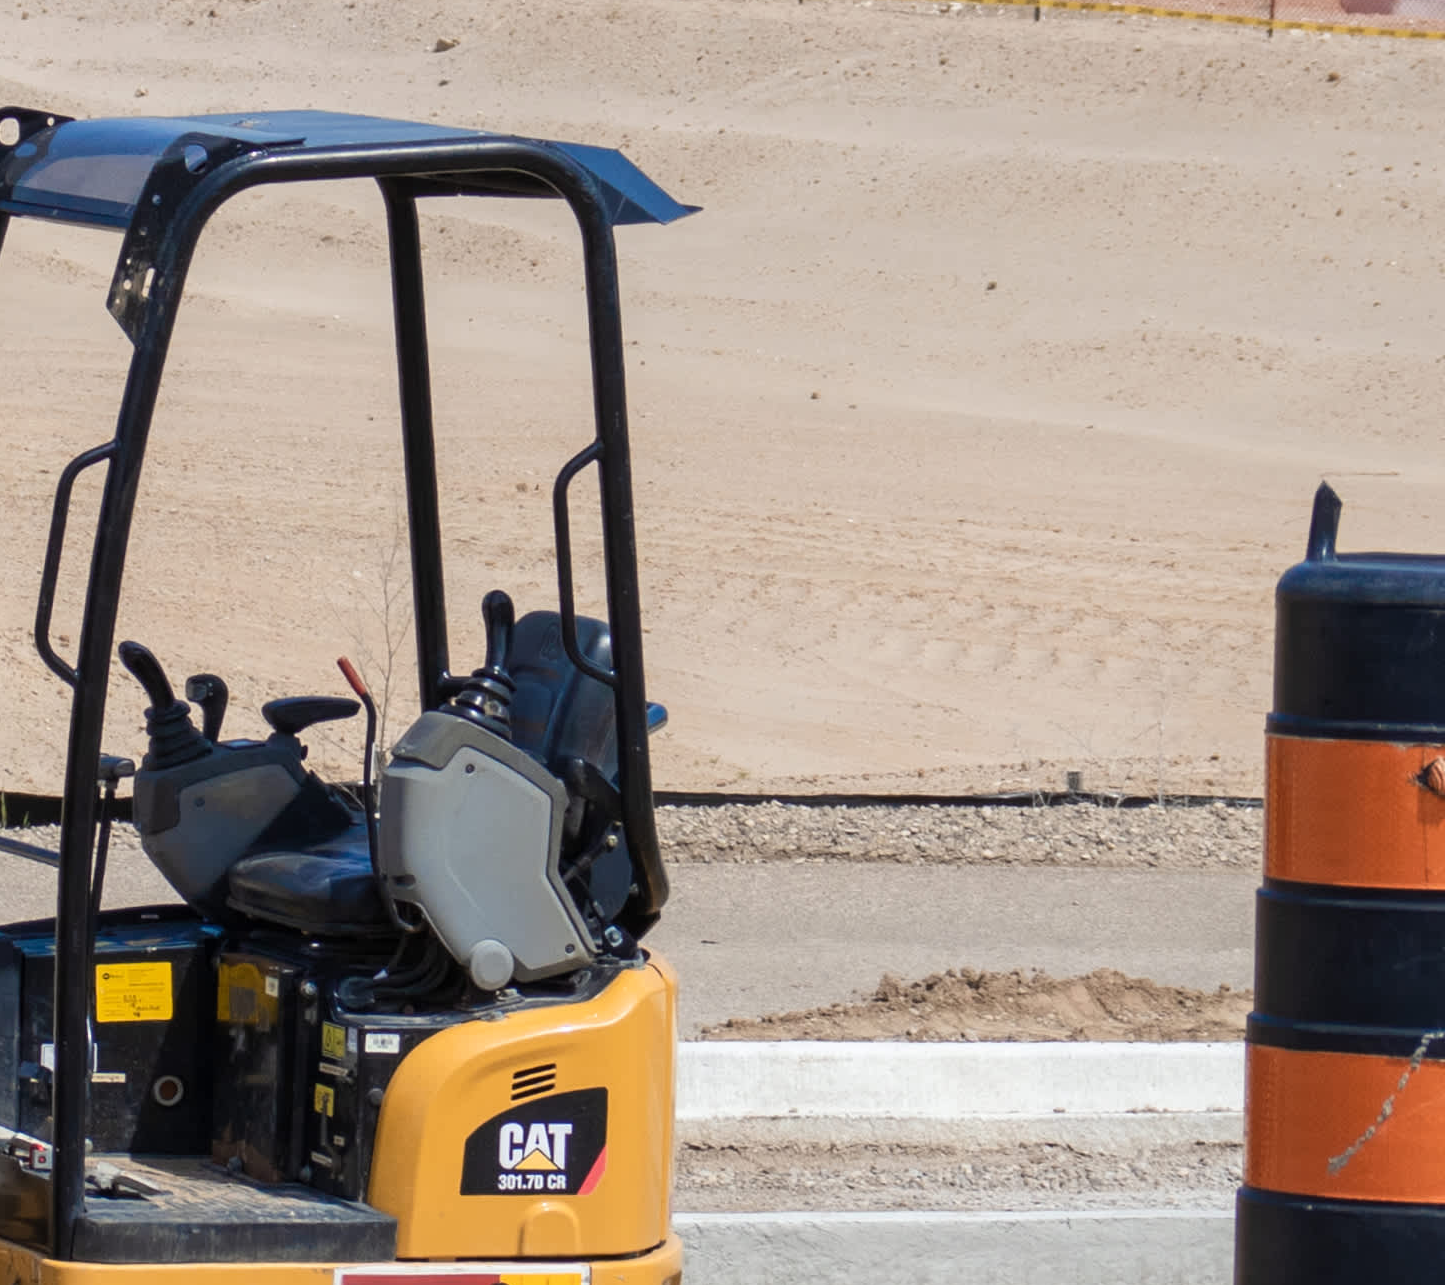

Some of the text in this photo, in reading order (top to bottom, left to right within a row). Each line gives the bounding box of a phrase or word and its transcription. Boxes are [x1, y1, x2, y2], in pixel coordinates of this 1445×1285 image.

[499, 1122, 573, 1170] CAT
[498, 1174, 567, 1190] 301.7D CR
